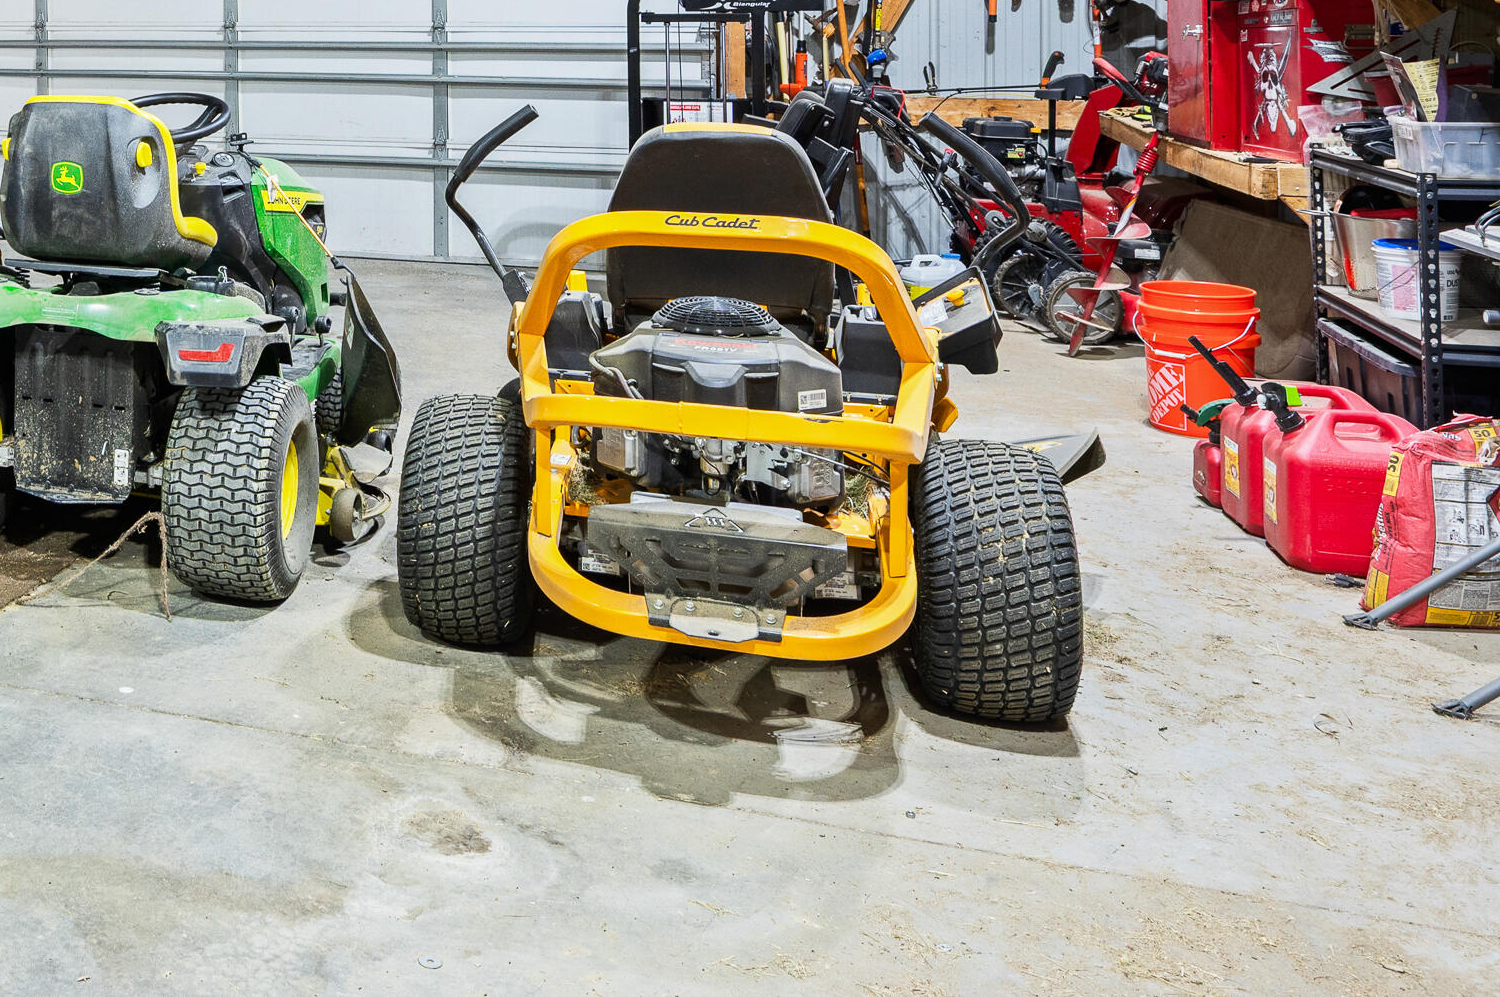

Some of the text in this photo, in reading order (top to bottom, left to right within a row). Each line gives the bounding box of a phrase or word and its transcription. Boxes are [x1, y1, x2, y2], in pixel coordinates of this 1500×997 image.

[665, 215, 761, 229] Cub Cadet
[1148, 363, 1184, 408] OME
[1152, 388, 1184, 423] DEPOT
[1473, 429, 1492, 438] 50
[1387, 455, 1399, 472] 50
